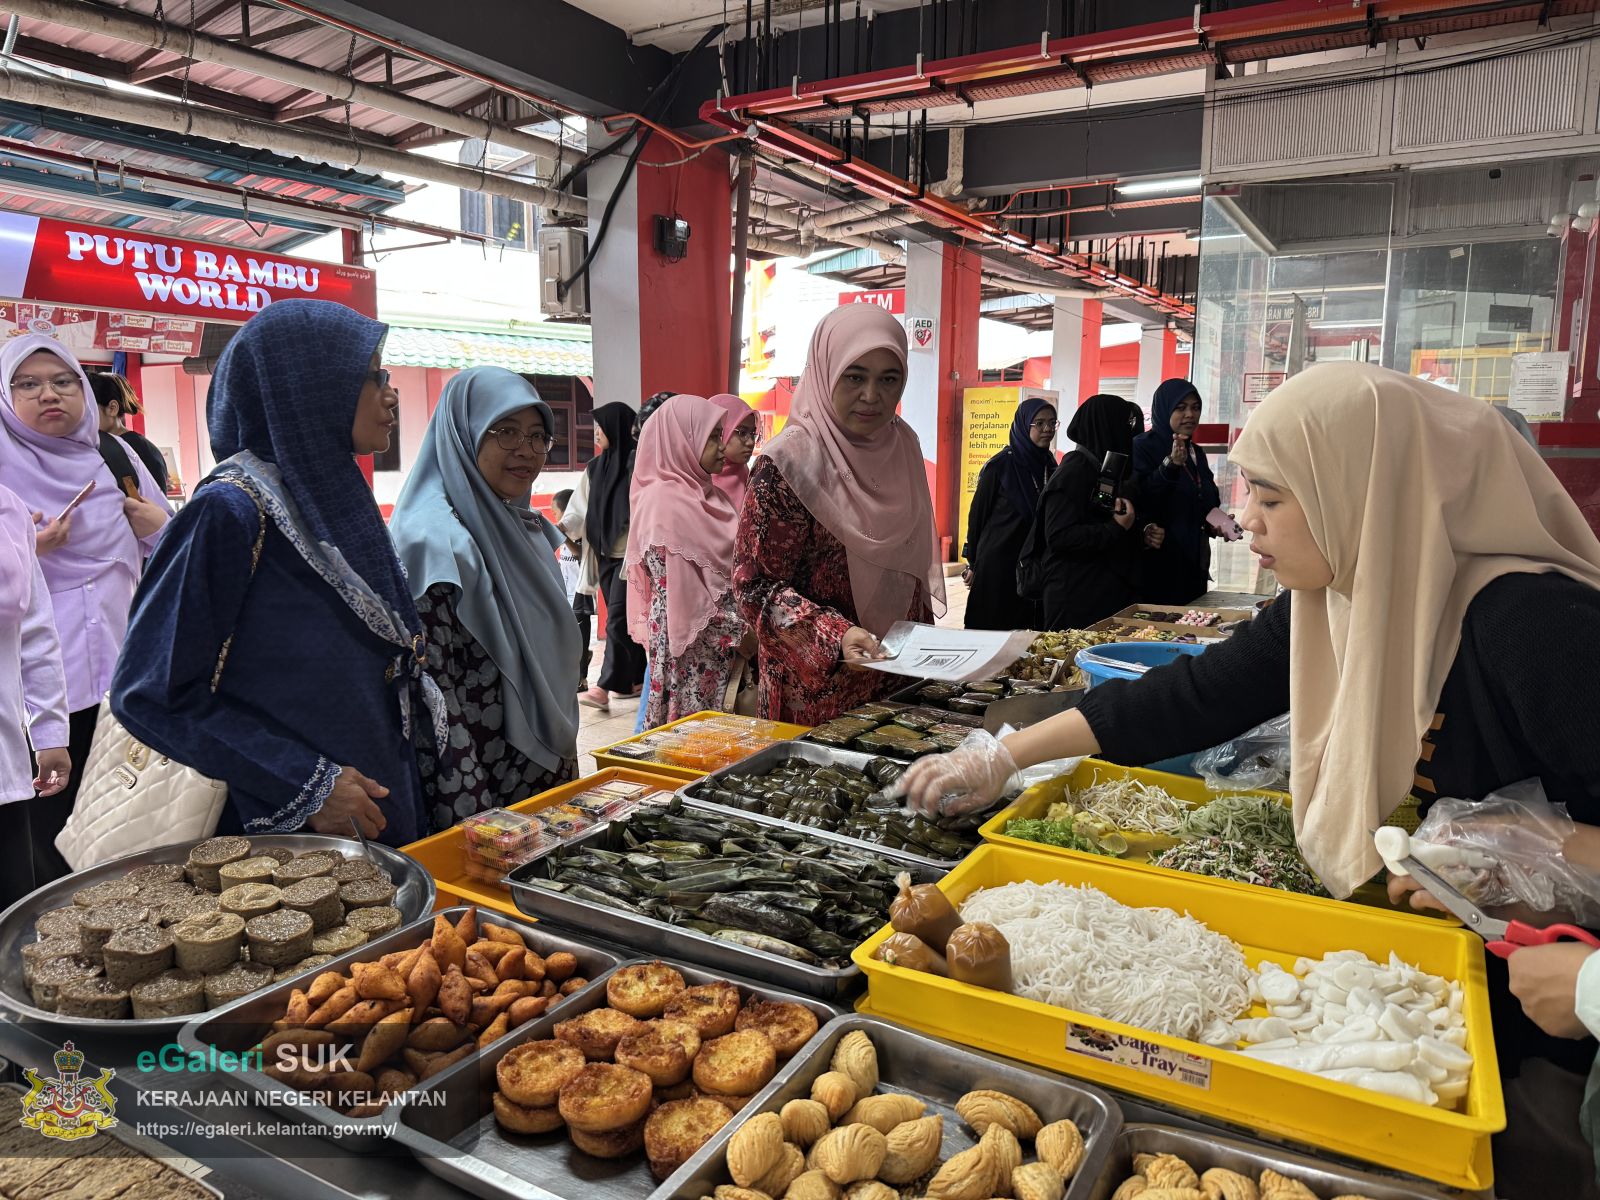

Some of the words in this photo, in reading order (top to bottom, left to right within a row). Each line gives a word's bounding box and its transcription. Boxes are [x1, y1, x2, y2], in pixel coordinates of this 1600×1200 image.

[65, 231, 183, 273] PUTU
[194, 250, 320, 292] BAMBU
[134, 271, 272, 312] WORLD
[853, 293, 893, 311] ATM
[71, 312, 80, 323] 5
[914, 320, 933, 328] AED
[970, 412, 1000, 420] Tempah
[969, 422, 1009, 430] perjalanan
[969, 432, 997, 440] dengan
[1118, 1034, 1160, 1054] Cake
[1139, 1050, 1178, 1076] Tray
